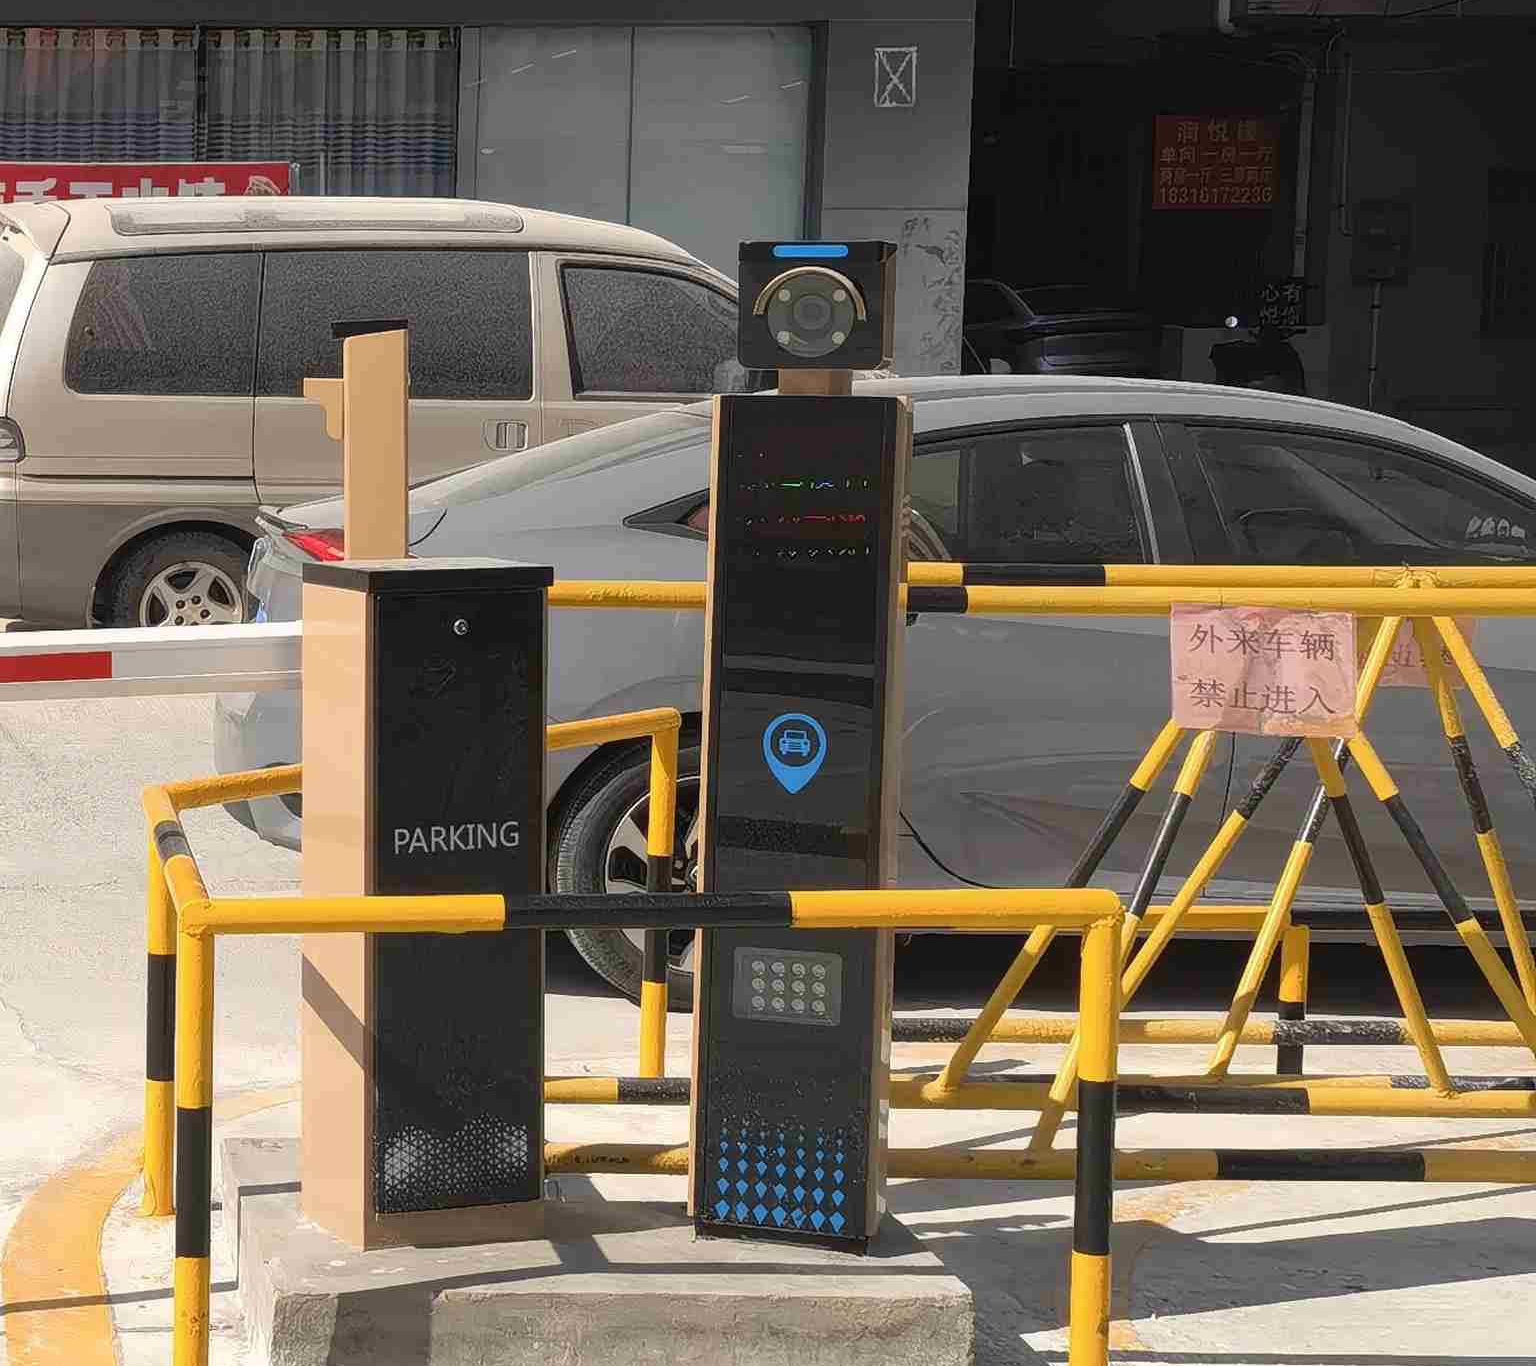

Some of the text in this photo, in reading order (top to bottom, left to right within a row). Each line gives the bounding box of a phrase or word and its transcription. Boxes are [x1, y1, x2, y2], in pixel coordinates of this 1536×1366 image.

[1189, 623, 1336, 662] 外来车辆
[1190, 678, 1336, 715] 禁止进入
[393, 820, 520, 855] PARKING
